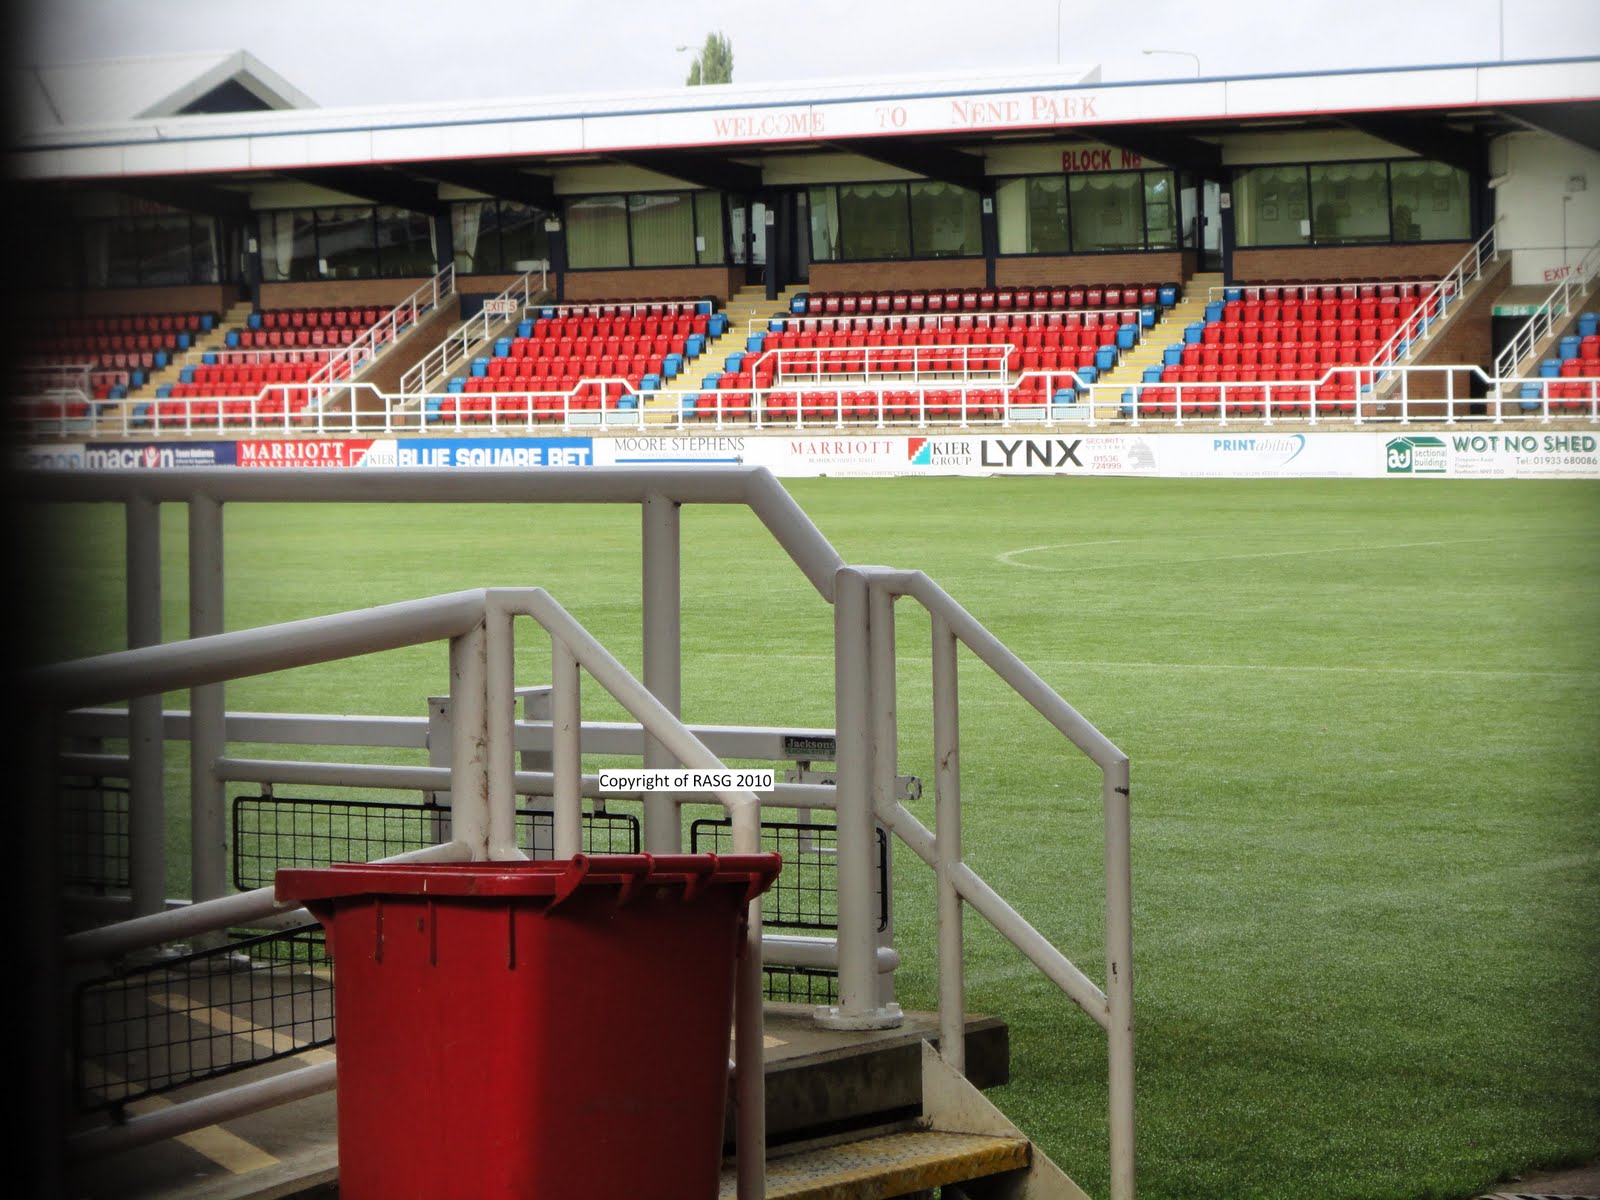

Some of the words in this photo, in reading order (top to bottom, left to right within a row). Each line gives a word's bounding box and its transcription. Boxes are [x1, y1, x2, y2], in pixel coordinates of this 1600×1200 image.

[713, 112, 825, 137] WELCOME
[875, 106, 907, 128] TO
[1062, 148, 1111, 171] BLOCK
[1544, 265, 1571, 282] EXIT
[485, 301, 505, 312] EXIT
[241, 442, 345, 459] MARRIOTT
[615, 437, 666, 451] MOORE
[672, 437, 745, 451] STEPHENS
[790, 440, 893, 455] MARRIOTT
[932, 442, 971, 455] KIER
[1452, 435, 1500, 453] WOT
[1504, 435, 1538, 453] NO
[1543, 435, 1597, 453] SHED
[370, 453, 394, 464] KIER
[398, 448, 450, 466] BLUE
[456, 448, 541, 466] SQUARE
[548, 448, 589, 466] BET
[981, 440, 1084, 467] LYNX
[1414, 448, 1447, 457] sectional
[931, 456, 972, 466] GROUP
[1414, 458, 1447, 468] buildings
[1533, 456, 1562, 465] 01933
[1563, 456, 1598, 465] 680086
[787, 738, 835, 749] Jacksons
